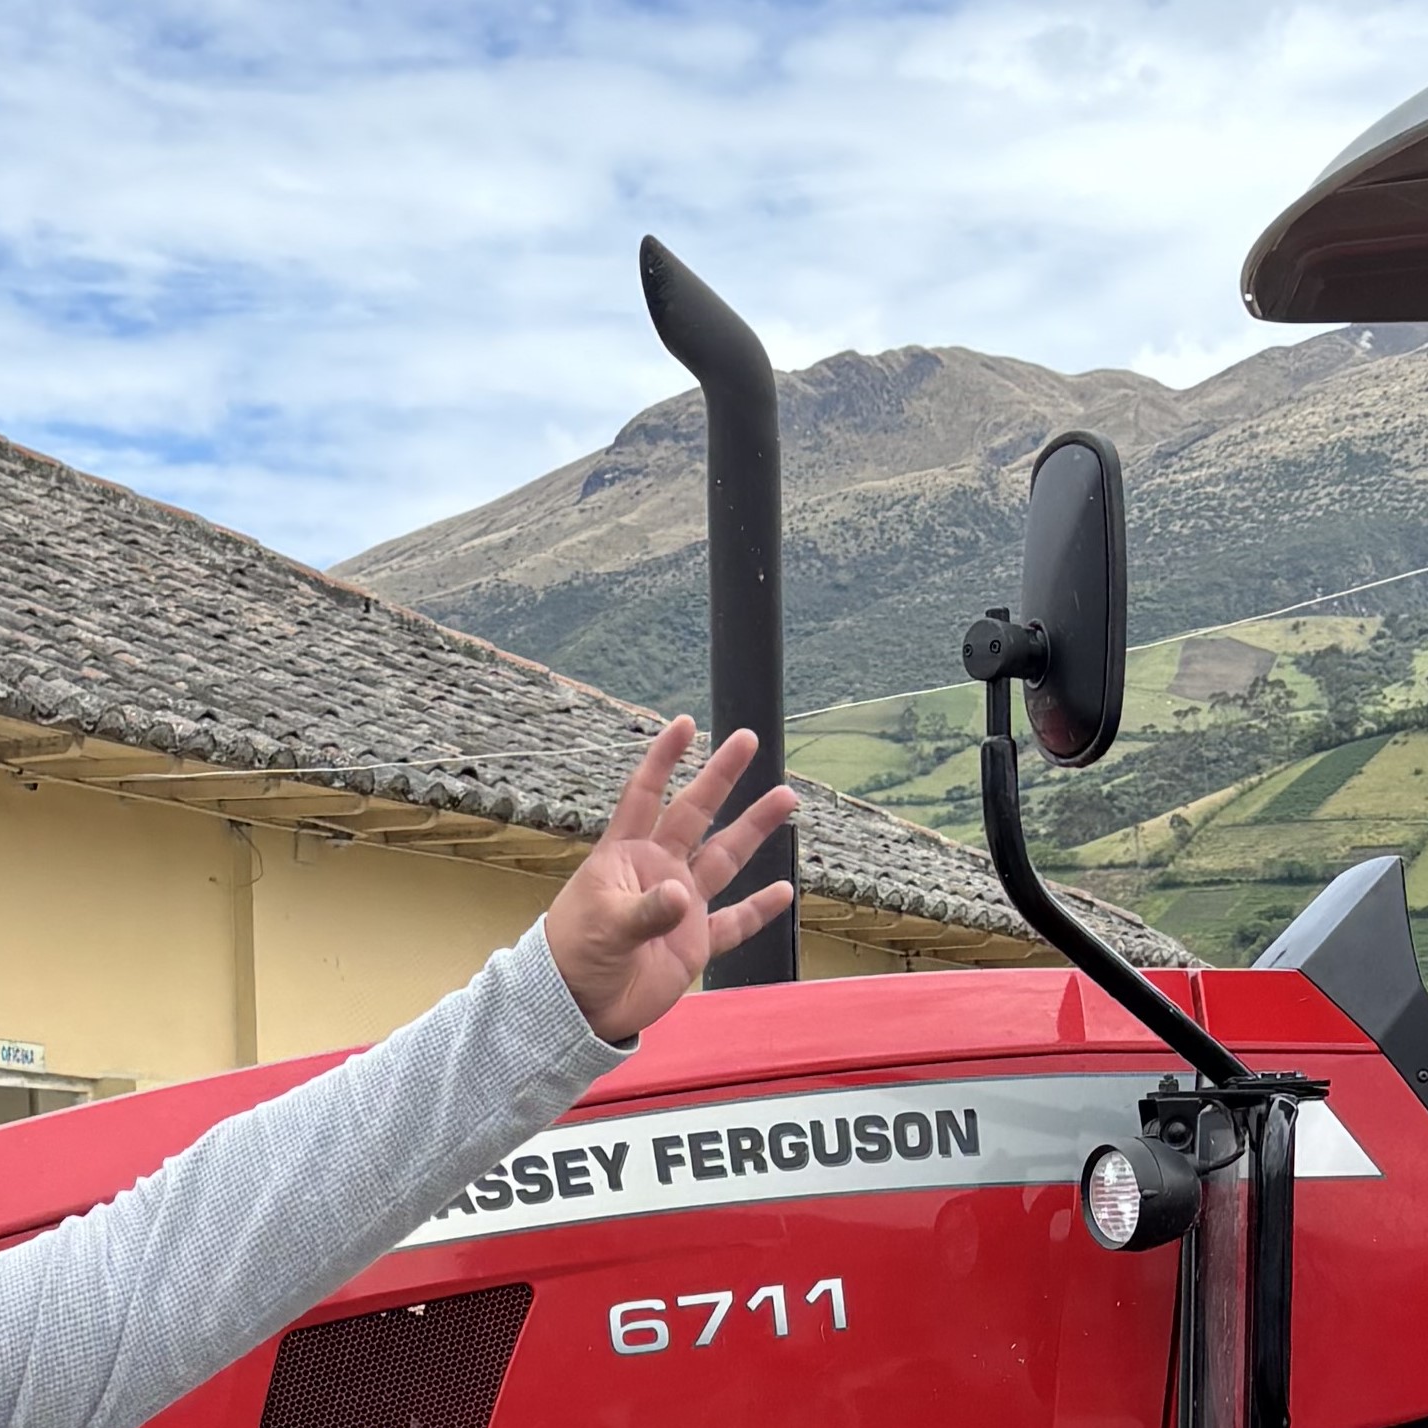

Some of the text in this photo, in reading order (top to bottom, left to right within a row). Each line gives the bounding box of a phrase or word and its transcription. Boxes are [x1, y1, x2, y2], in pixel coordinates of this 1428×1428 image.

[434, 1107, 981, 1221] SSEY FERGUSON
[608, 1277, 849, 1356] 6711
